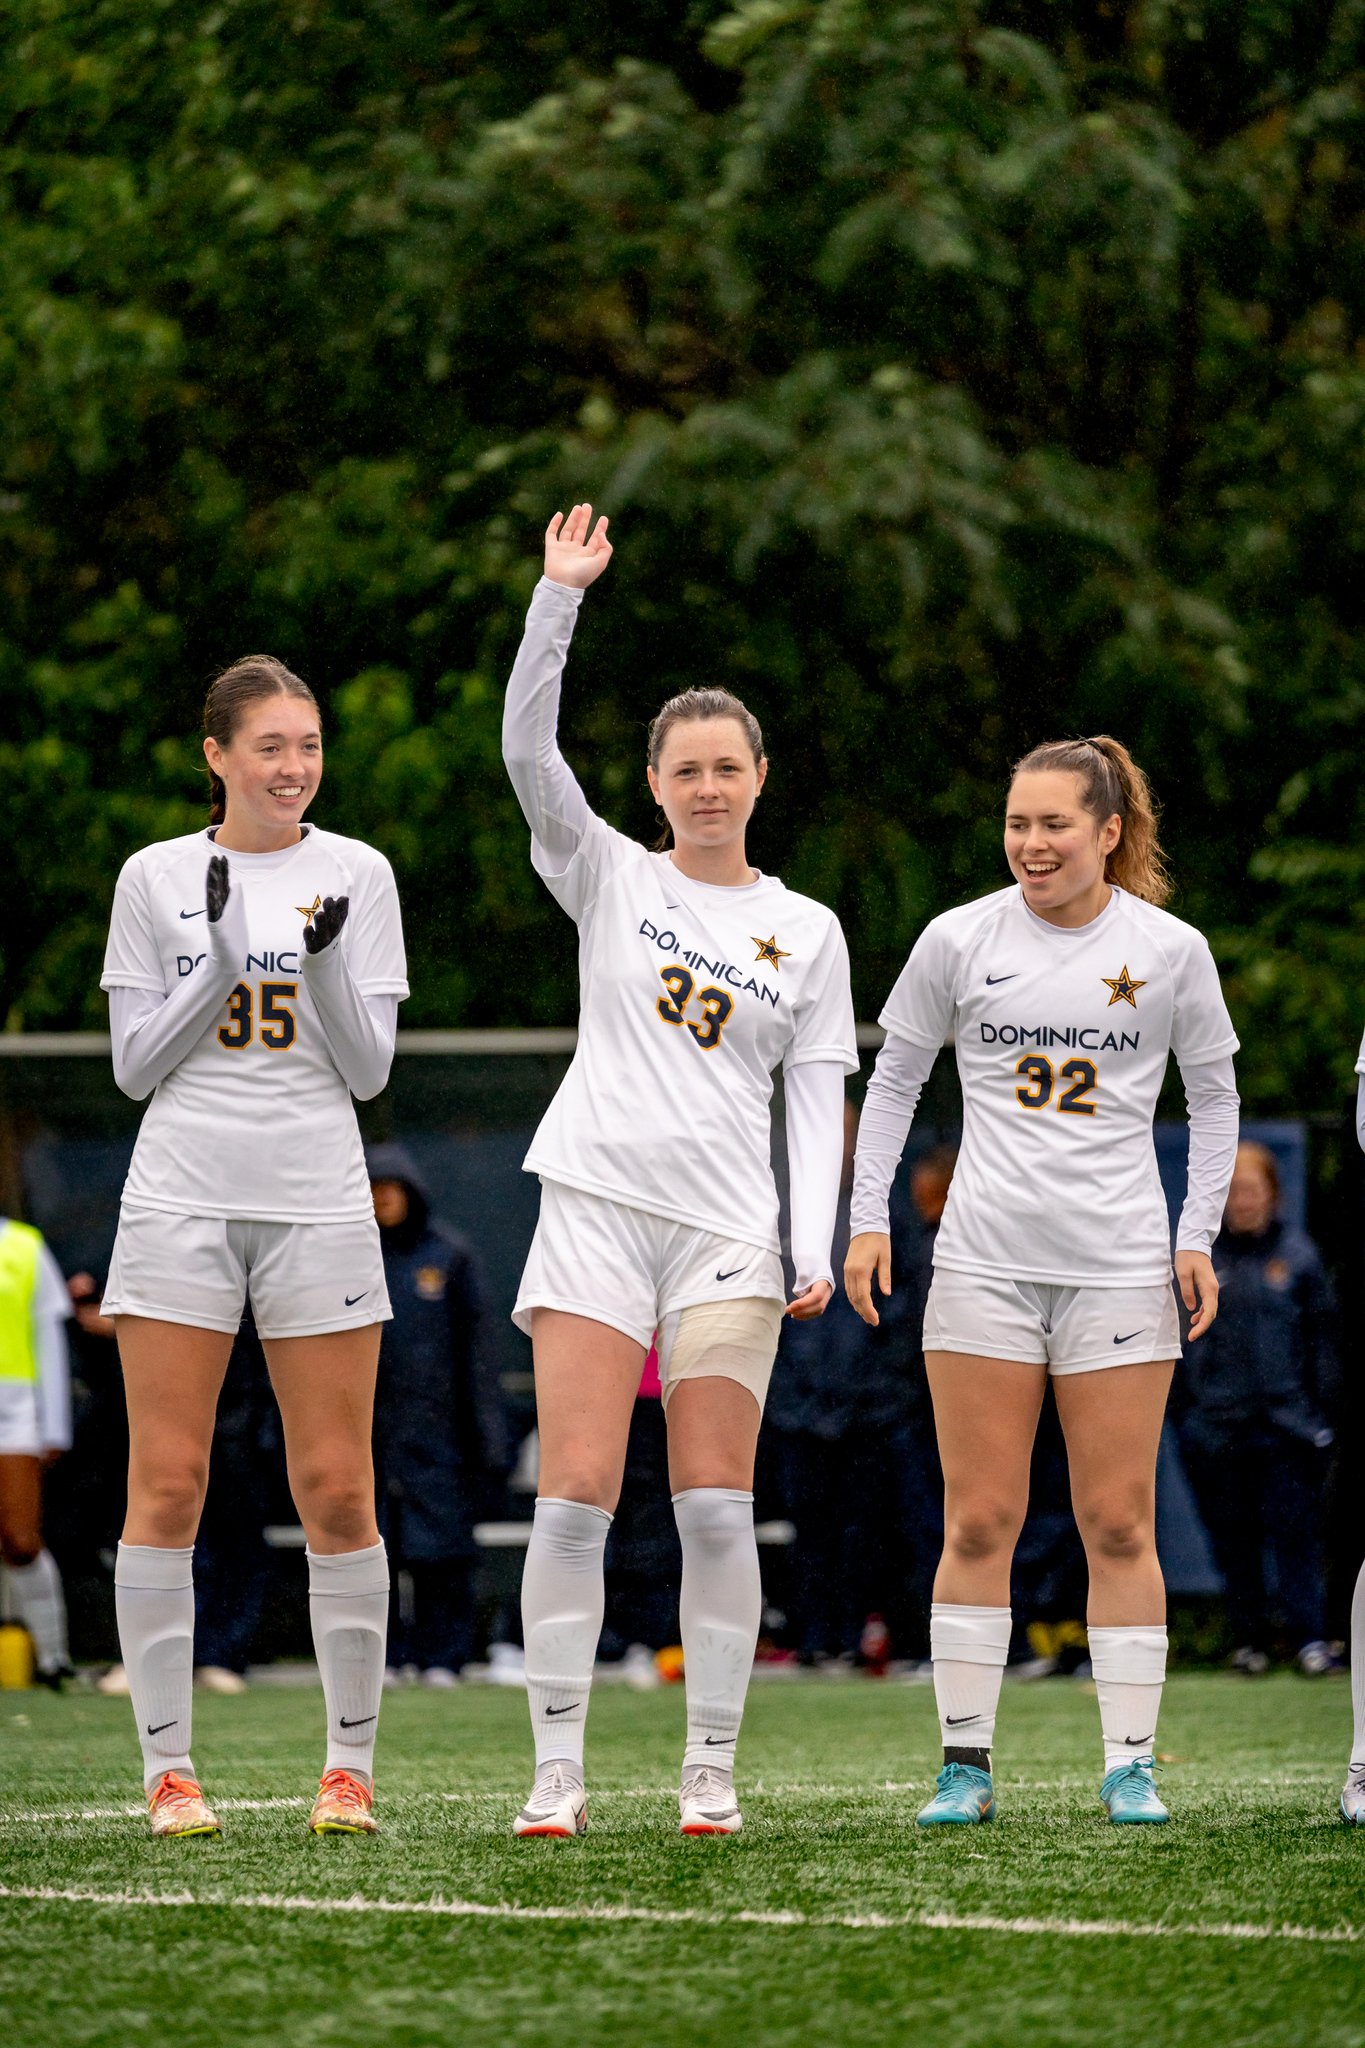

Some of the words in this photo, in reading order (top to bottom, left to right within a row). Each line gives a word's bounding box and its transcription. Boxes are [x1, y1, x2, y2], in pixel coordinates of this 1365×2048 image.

[217, 980, 298, 1051] 35
[656, 964, 735, 1051] 33
[980, 1022, 1140, 1052] DOMINICAN
[1015, 1053, 1098, 1117] 32
